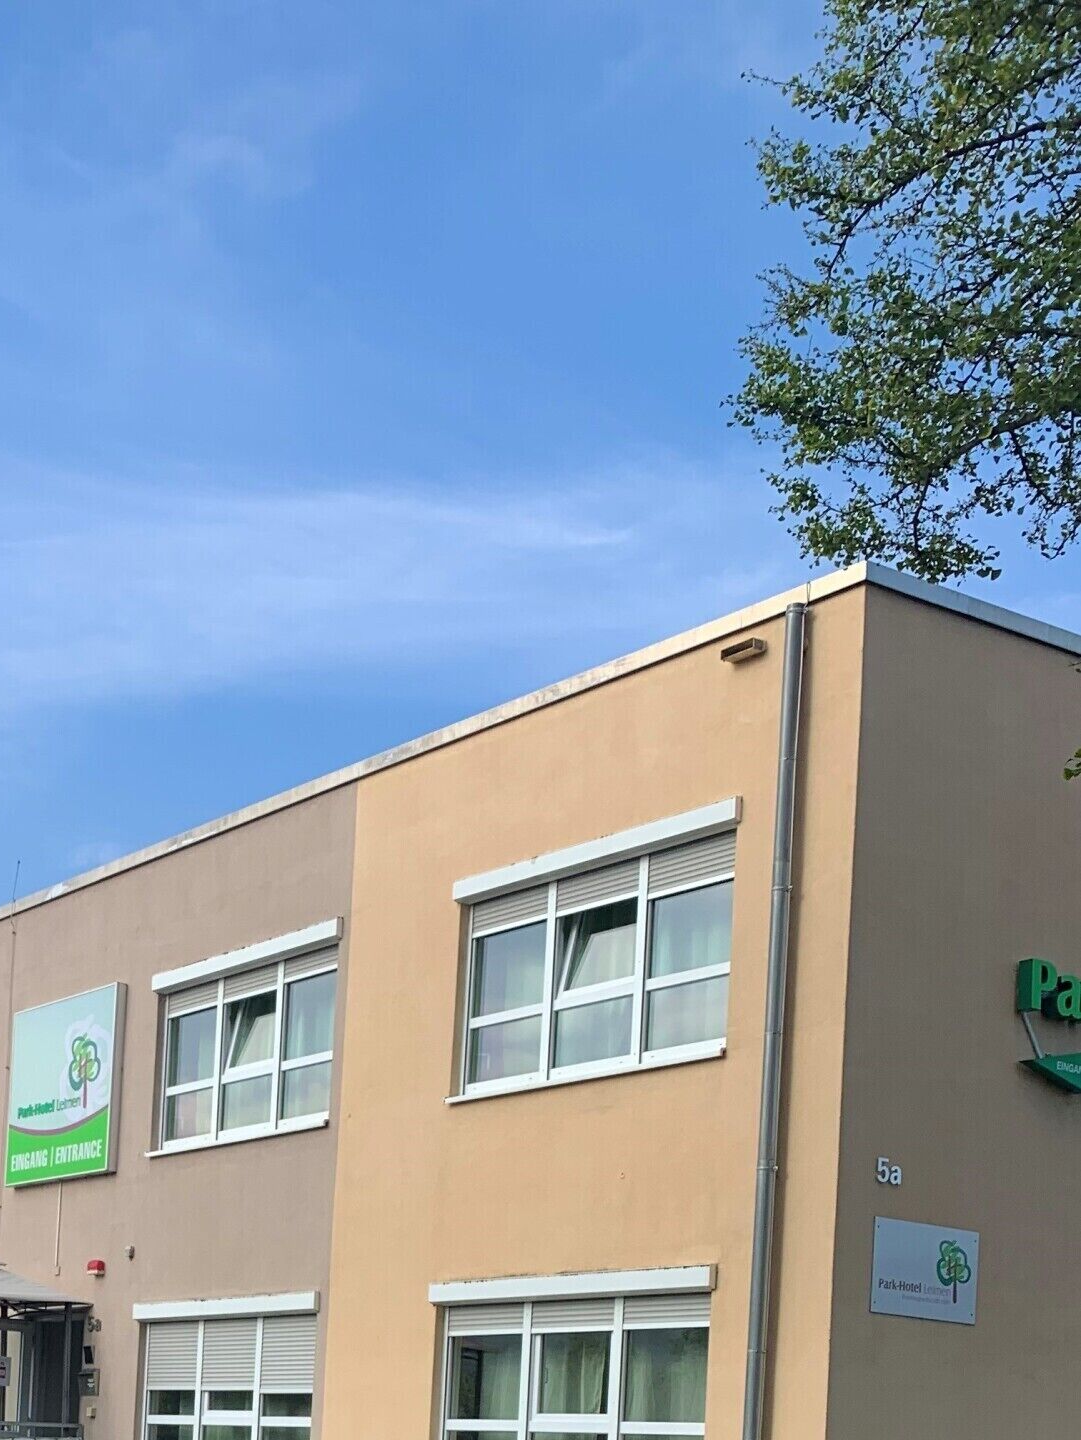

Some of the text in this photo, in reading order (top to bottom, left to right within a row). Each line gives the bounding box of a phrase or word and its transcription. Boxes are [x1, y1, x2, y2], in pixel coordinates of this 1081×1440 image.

[17, 1097, 81, 1119] Park-Hotel Leimen
[11, 1149, 48, 1172] EINGANG
[55, 1139, 103, 1164] ENTRANCE
[877, 1156, 902, 1185] 5a
[878, 1278, 922, 1293] Park-Hotel
[87, 1316, 102, 1333] 5a
